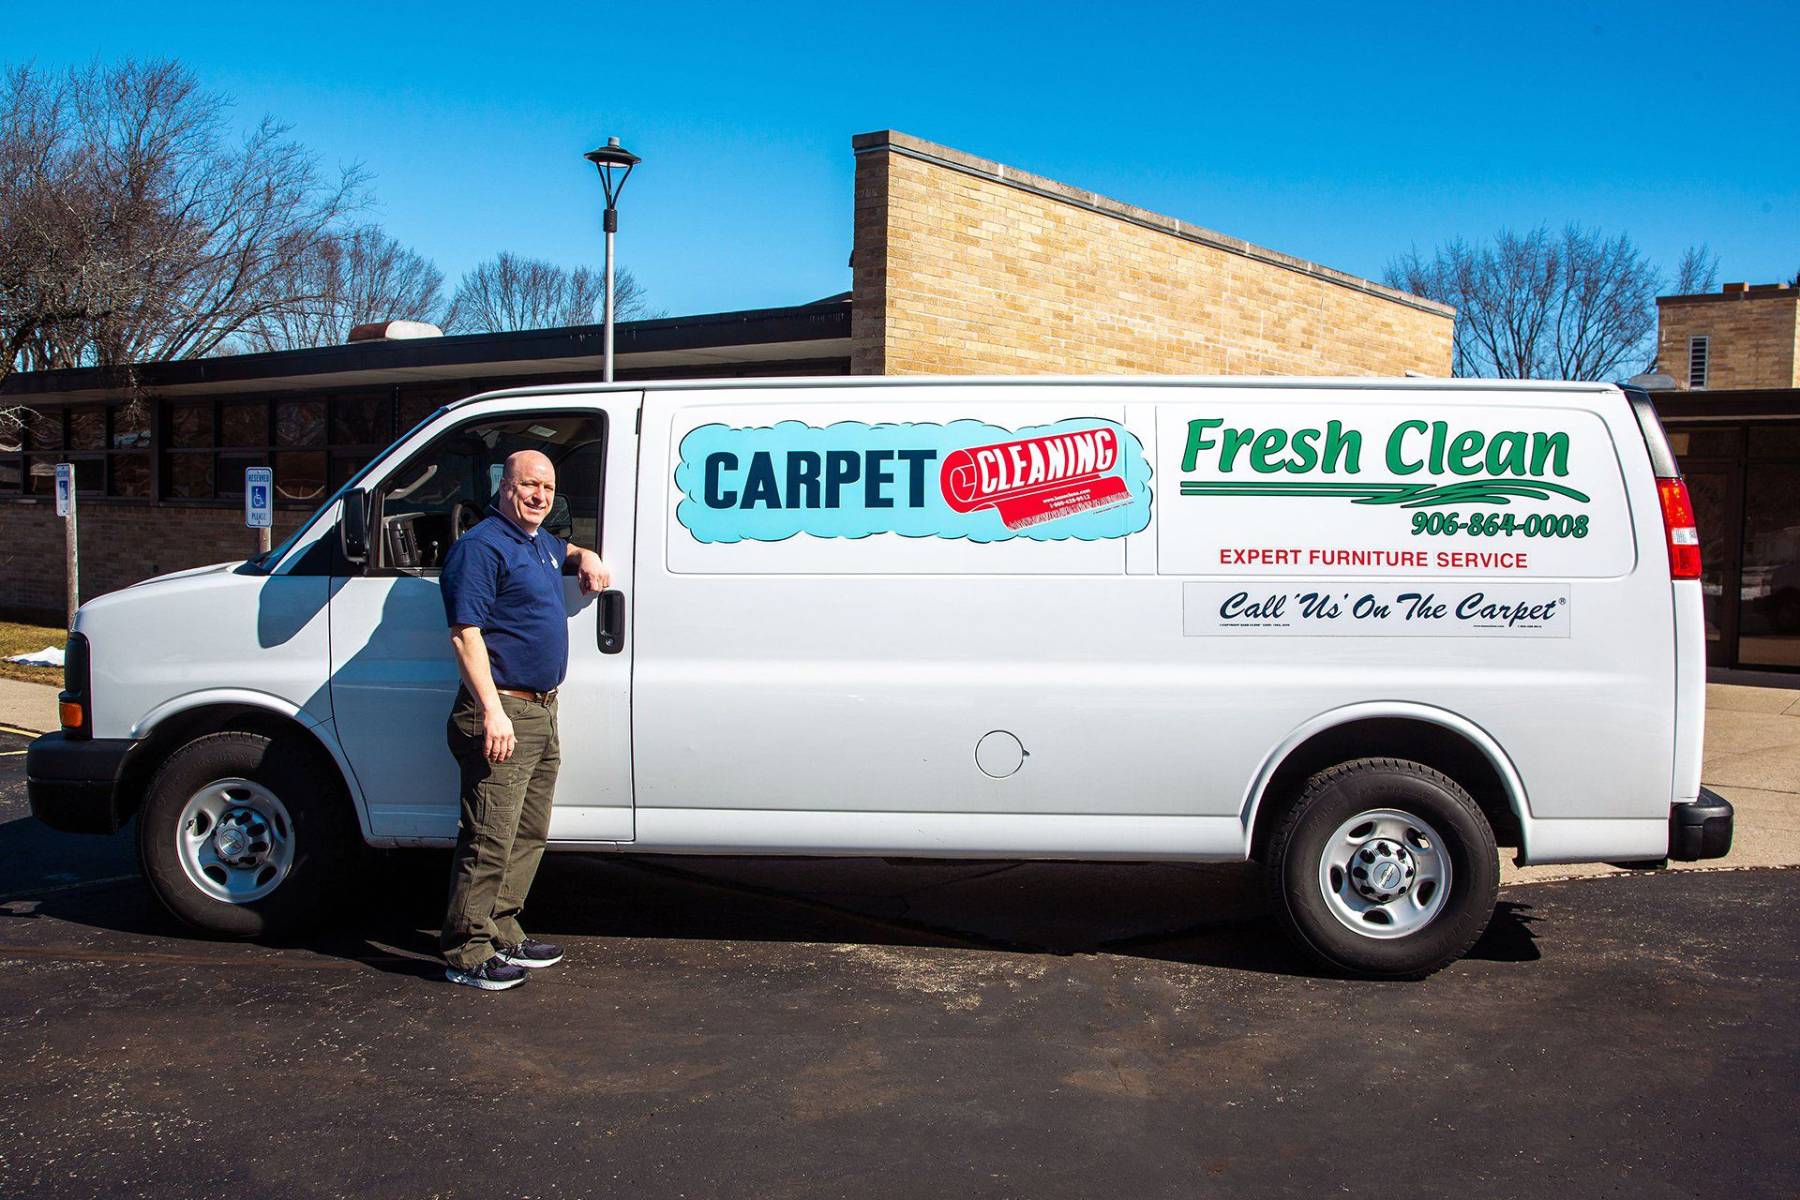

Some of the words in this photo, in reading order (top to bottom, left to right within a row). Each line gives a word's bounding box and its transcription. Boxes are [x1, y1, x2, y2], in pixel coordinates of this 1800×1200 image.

[976, 430, 1114, 494] CLEANING
[1181, 417, 1363, 474] Fresh
[1385, 419, 1570, 477] Clean
[704, 449, 938, 510] CARPET
[1411, 511, 1590, 538] 906-864-0008
[1220, 548, 1302, 565] EXPERT
[1309, 550, 1428, 567] FURNITURE
[1436, 551, 1528, 569] SERVICE
[1219, 591, 1287, 619] Call
[1352, 593, 1392, 620] On
[1396, 592, 1448, 621] The
